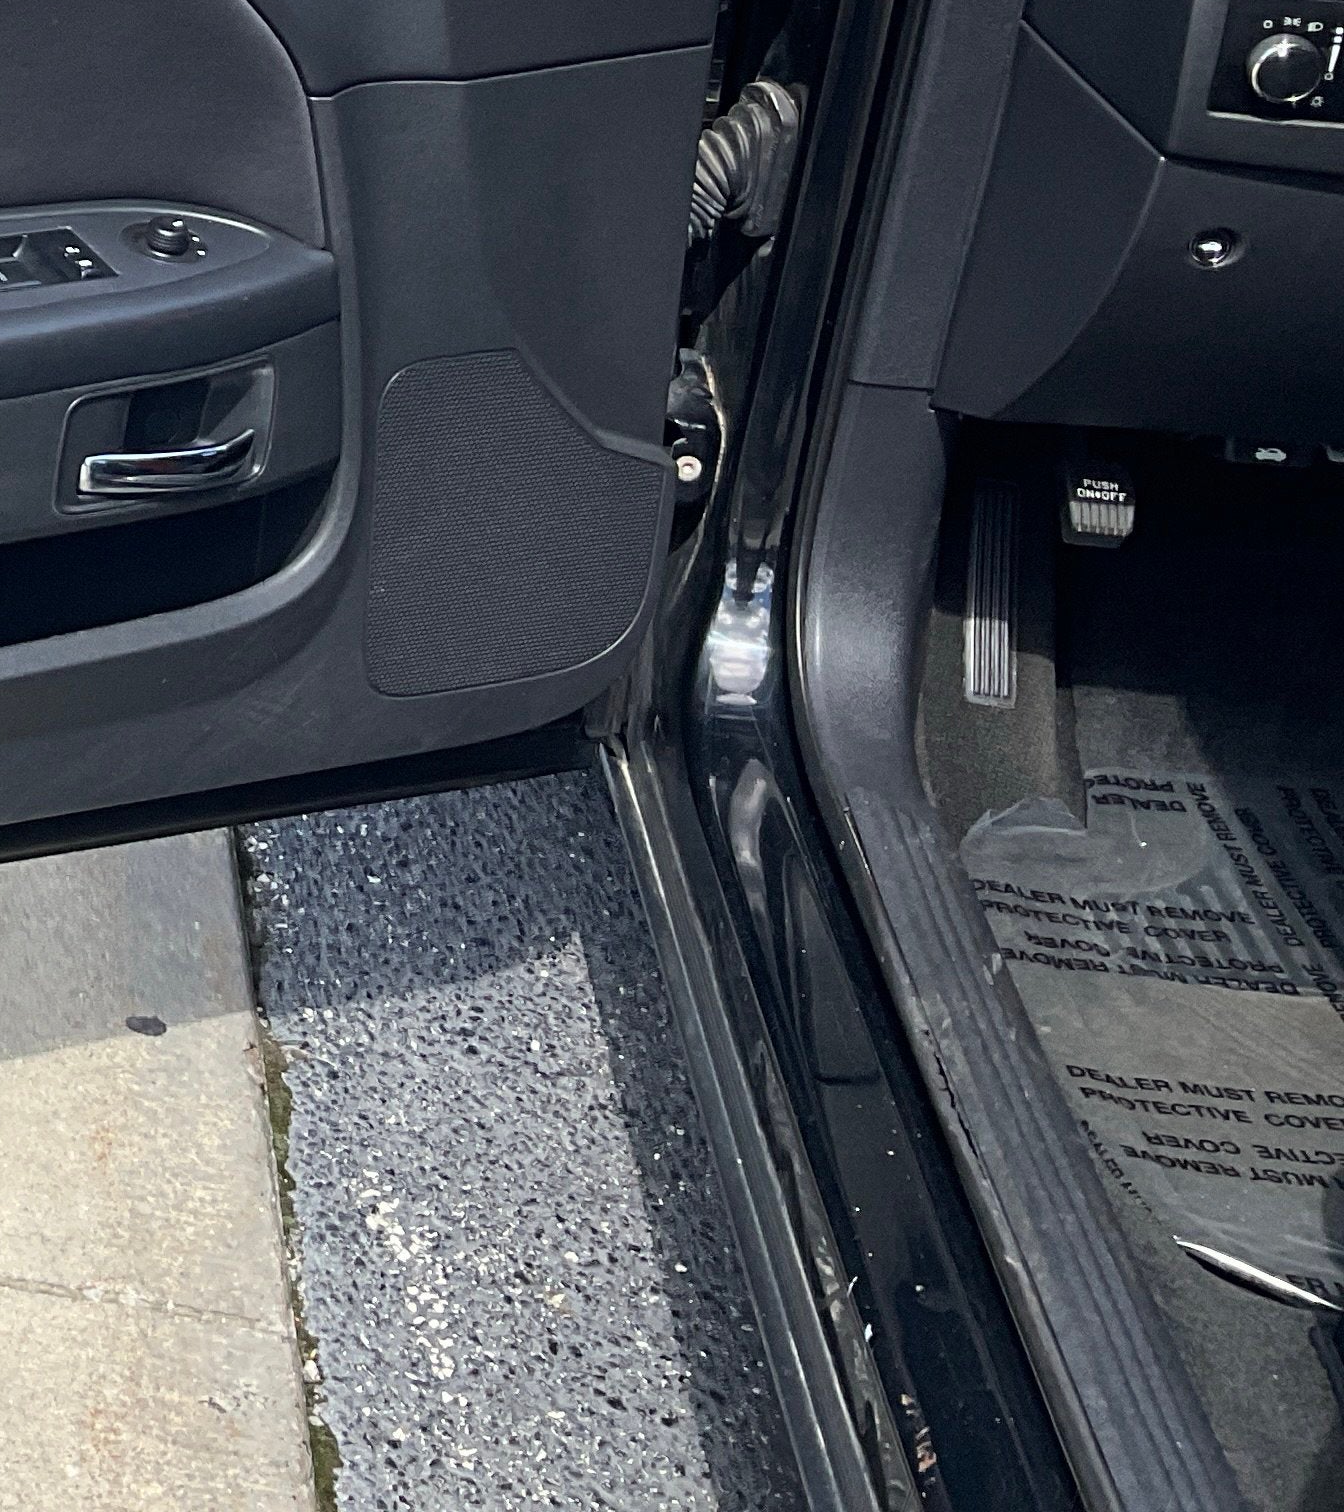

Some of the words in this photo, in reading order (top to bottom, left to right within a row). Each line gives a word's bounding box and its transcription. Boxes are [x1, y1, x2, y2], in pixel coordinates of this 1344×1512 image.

[1083, 478, 1119, 491] PUSH
[1092, 792, 1187, 812] DEALER
[1186, 782, 1237, 842] REMOVE
[1224, 844, 1263, 887] MUST
[973, 879, 1066, 905] DEALER
[1146, 904, 1255, 924] REMOVE
[1252, 888, 1306, 947] DEALER
[1267, 860, 1338, 949] PROTECTIVE
[980, 899, 1133, 934] PROTECTIVE
[1144, 925, 1232, 944] COVER
[1001, 948, 1110, 973] REMOVE
[1126, 946, 1285, 974] PROTECTIVE
[1066, 1064, 1174, 1093] DEALER
[1178, 1081, 1255, 1103] MUST
[1078, 1086, 1253, 1124] PROTECTIVE
[1264, 1113, 1344, 1131] COVE
[1118, 1144, 1242, 1178] REMOVE
[1141, 1131, 1241, 1155] COVER
[1250, 1166, 1330, 1188] MUST
